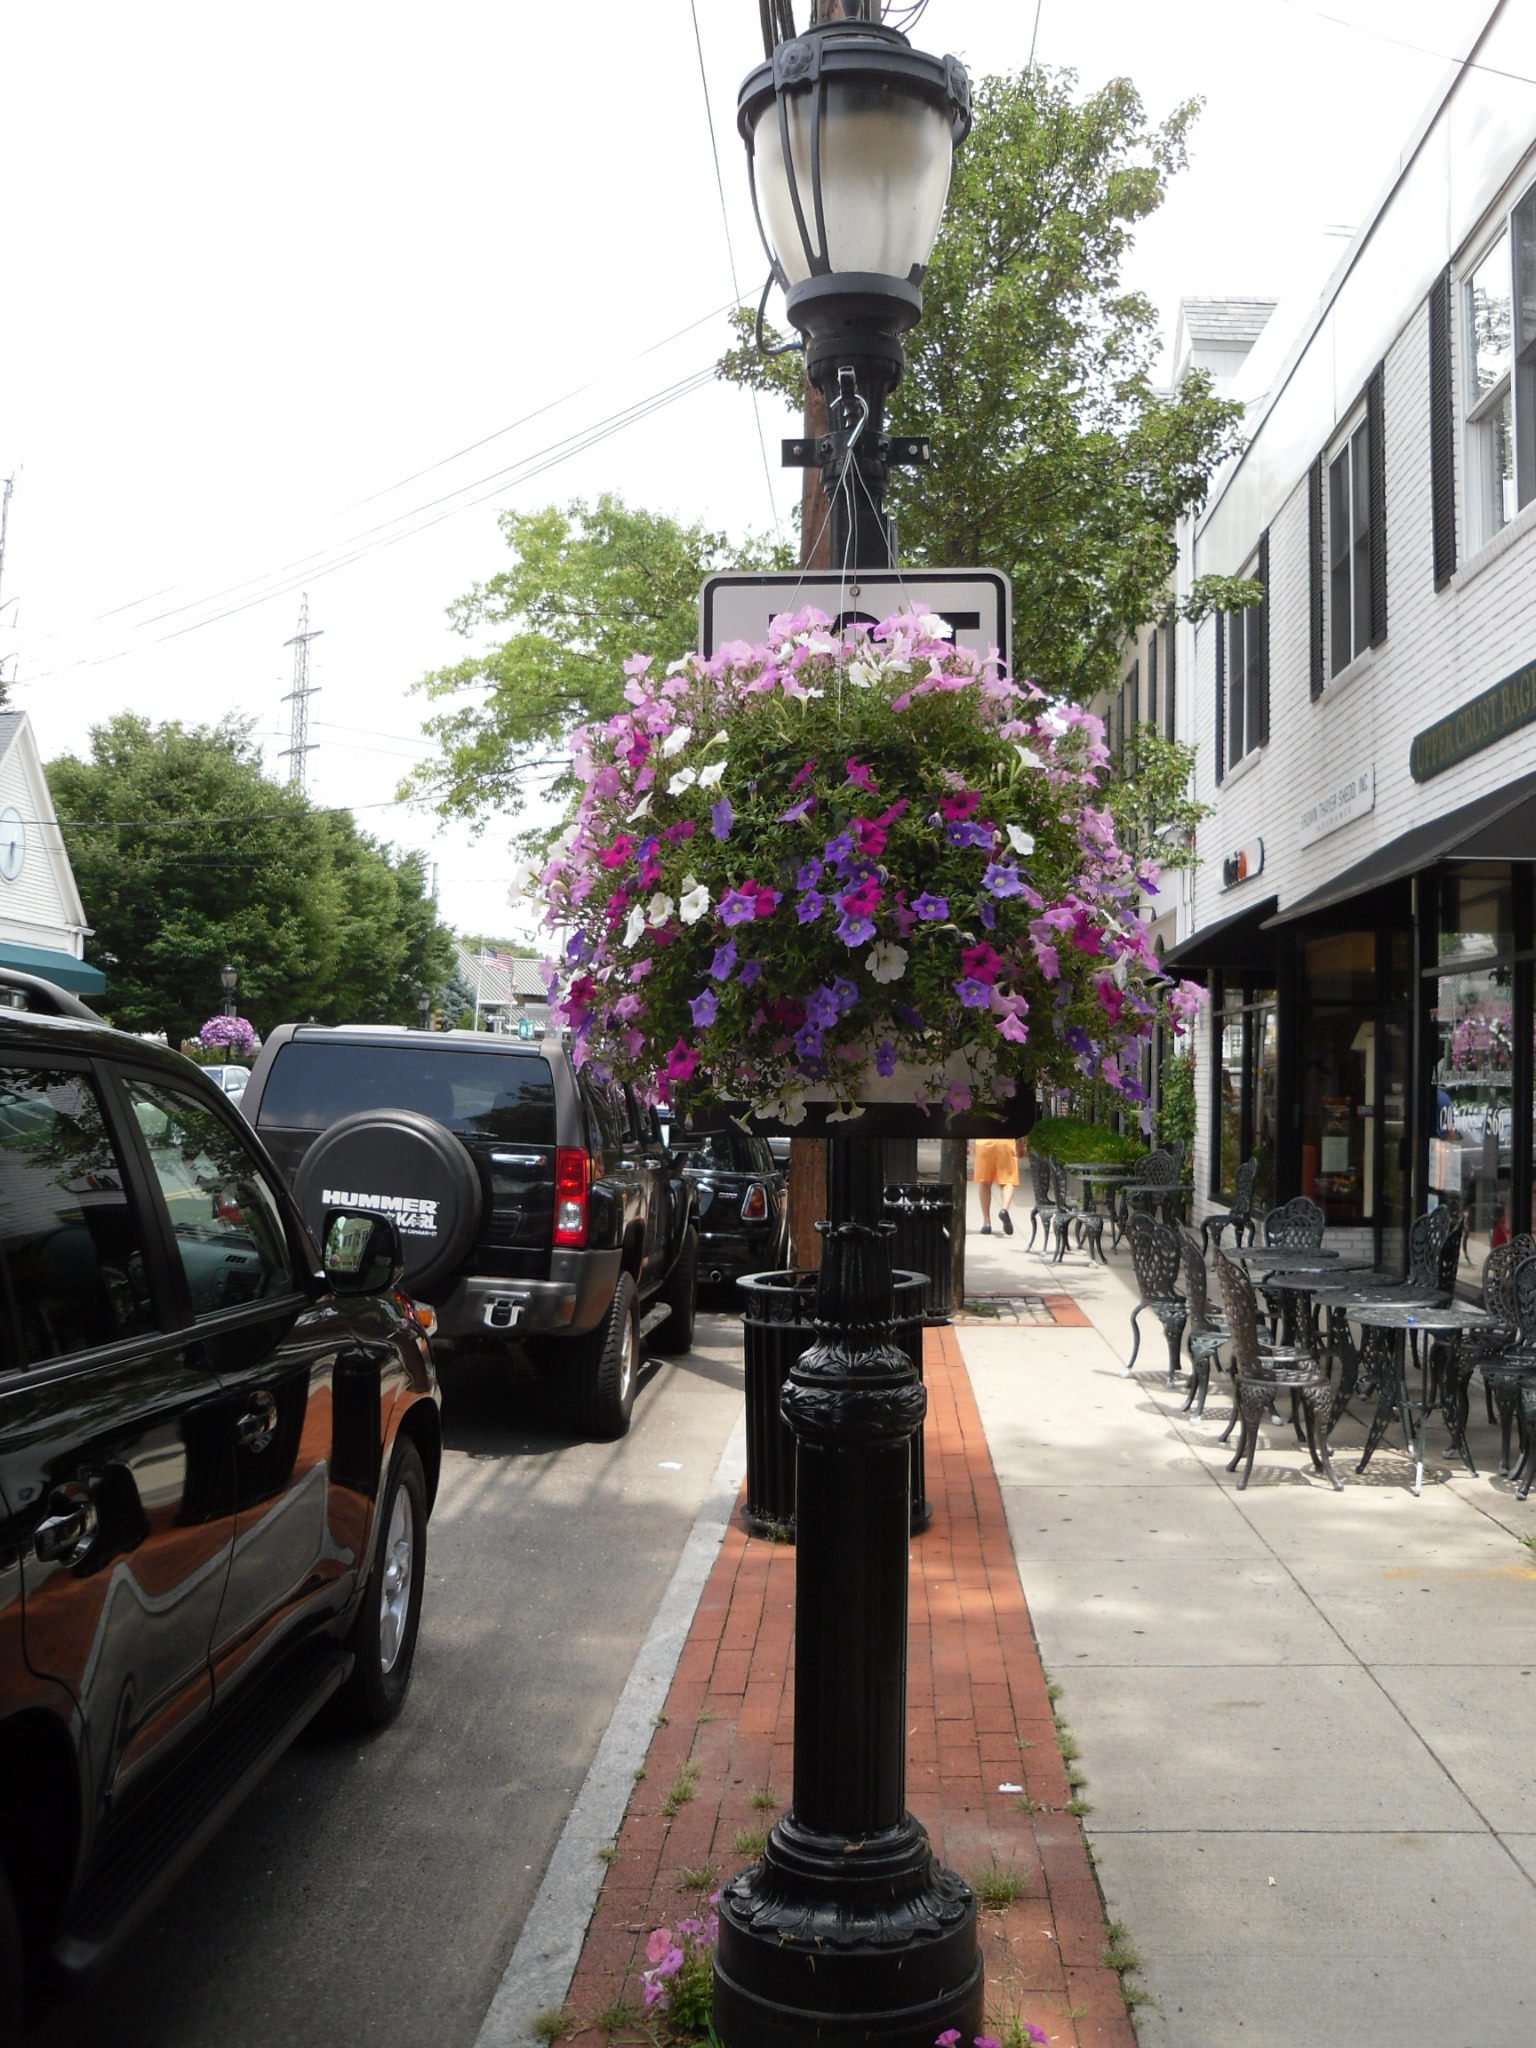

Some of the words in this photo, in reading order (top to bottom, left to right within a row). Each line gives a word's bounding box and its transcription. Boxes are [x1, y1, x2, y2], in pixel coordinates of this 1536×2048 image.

[1415, 720, 1454, 773] UPPER
[1455, 693, 1497, 749] CRUST
[322, 1190, 438, 1214] HUMMER
[396, 1212, 437, 1229] KARL
